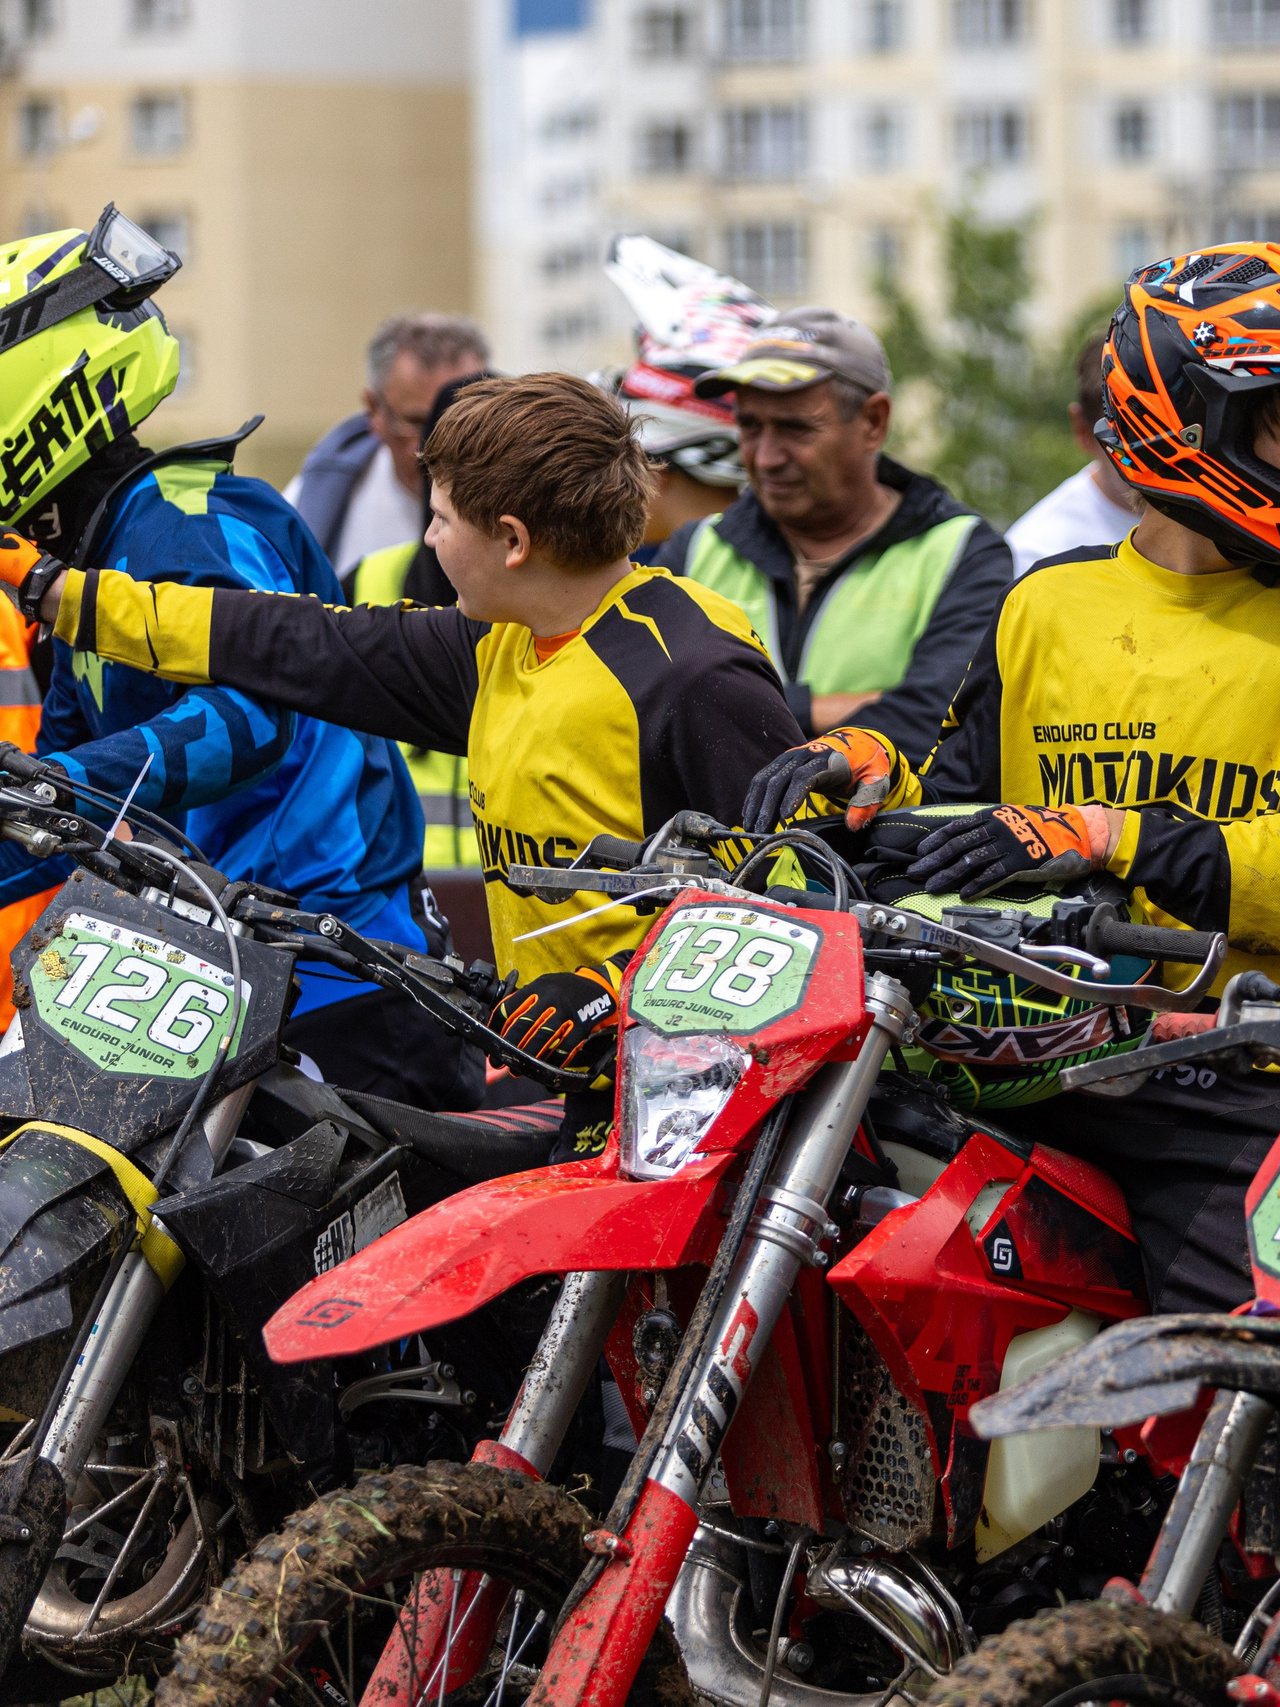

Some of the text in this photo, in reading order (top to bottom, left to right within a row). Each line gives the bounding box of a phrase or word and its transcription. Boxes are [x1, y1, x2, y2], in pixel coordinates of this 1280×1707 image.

[1202, 344, 1273, 358] SUB
[1032, 721, 1157, 744] ENDURO CLUB
[991, 804, 1047, 860] astars
[643, 925, 794, 1007] 138
[53, 942, 230, 1055] 126
[664, 1014, 683, 1026] J2
[685, 1002, 734, 1022] JUNIOR
[60, 1017, 175, 1069] ENDURO JUNIOR
[99, 1051, 121, 1067] J2
